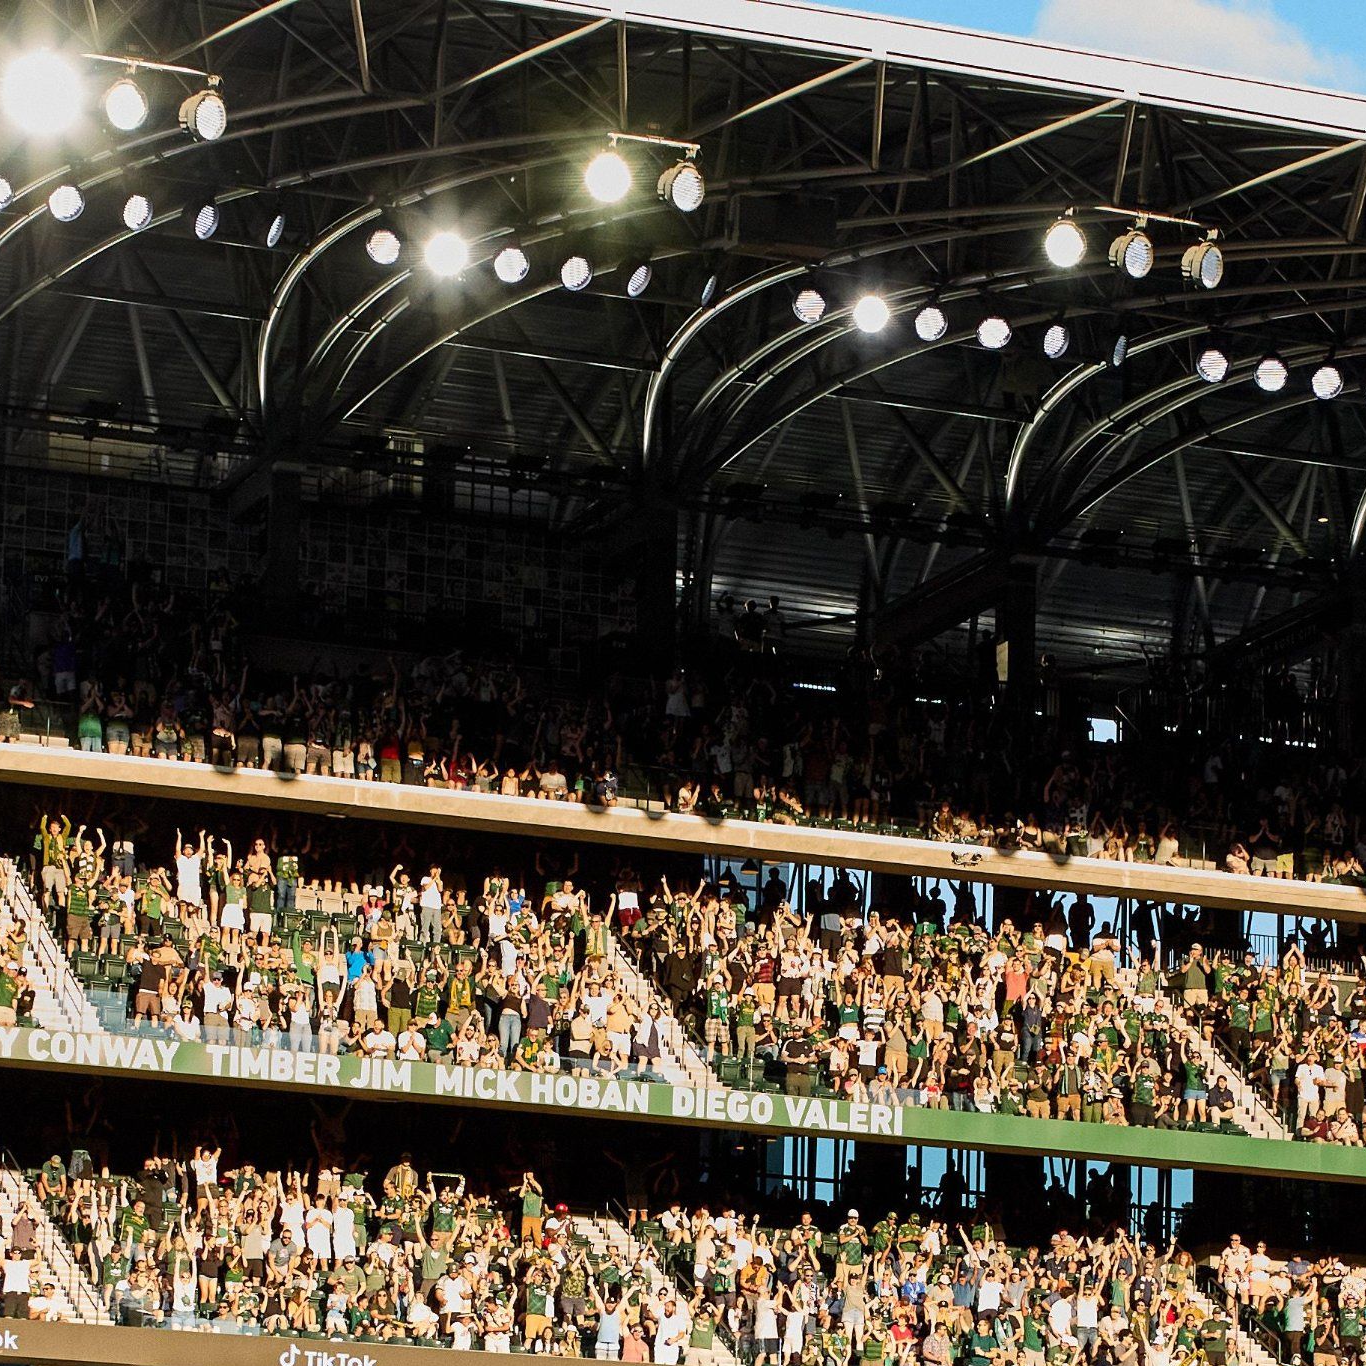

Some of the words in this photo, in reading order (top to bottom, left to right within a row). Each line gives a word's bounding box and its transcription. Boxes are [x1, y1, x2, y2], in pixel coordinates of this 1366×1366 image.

[28, 1030, 180, 1072] CONWAY
[206, 1043, 341, 1086] TIMBER
[349, 1058, 412, 1093] JIM
[436, 1065, 521, 1103] MICK
[530, 1072, 650, 1114] HOBAN
[672, 1085, 773, 1124] DIEGO
[785, 1096, 903, 1137] VALERI
